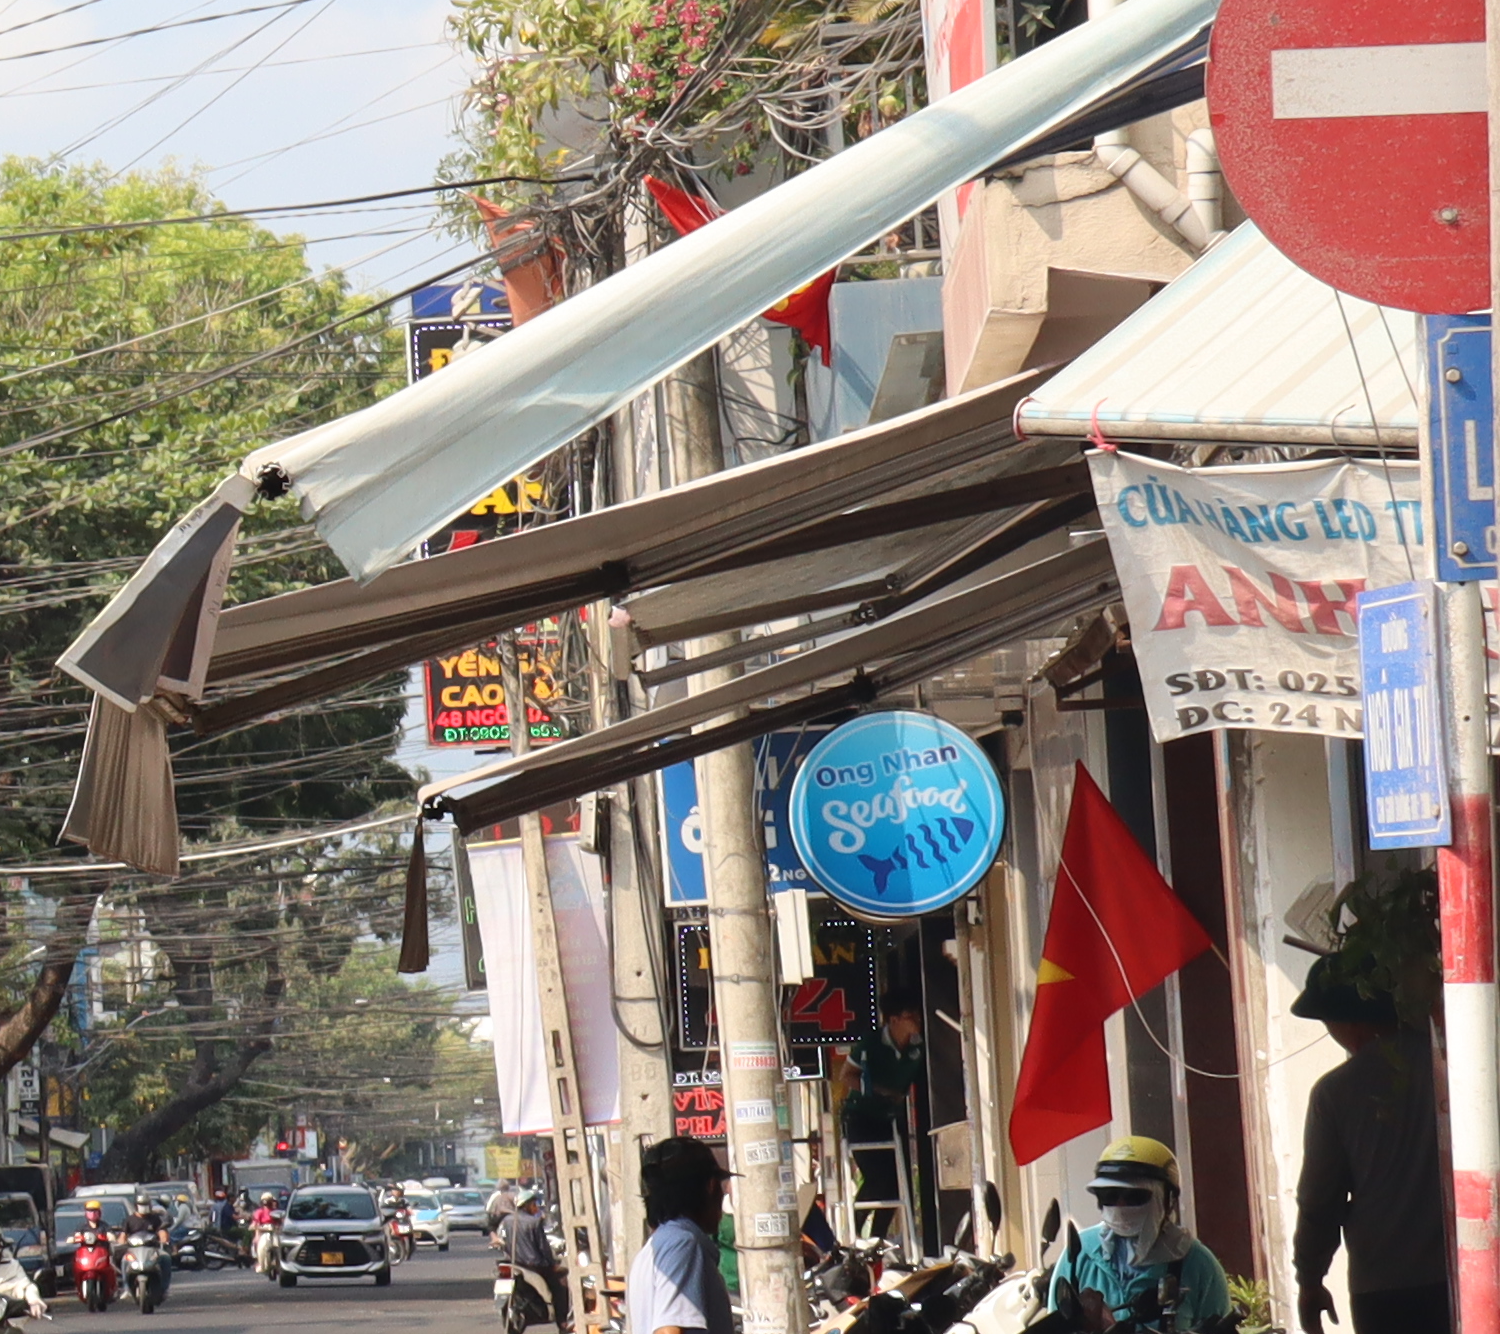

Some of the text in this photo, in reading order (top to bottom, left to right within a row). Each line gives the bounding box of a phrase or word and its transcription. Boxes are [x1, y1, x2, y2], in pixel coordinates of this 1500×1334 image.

[1116, 474, 1202, 528] CỬA
[1200, 498, 1308, 544] HÀNG
[1312, 498, 1377, 542] LED
[441, 683, 504, 708] CAO
[1164, 667, 1265, 697] SĐT:
[1175, 700, 1321, 732] ĐC: 24
[816, 744, 958, 787] Ong Nhan
[821, 774, 968, 854] Seafood
